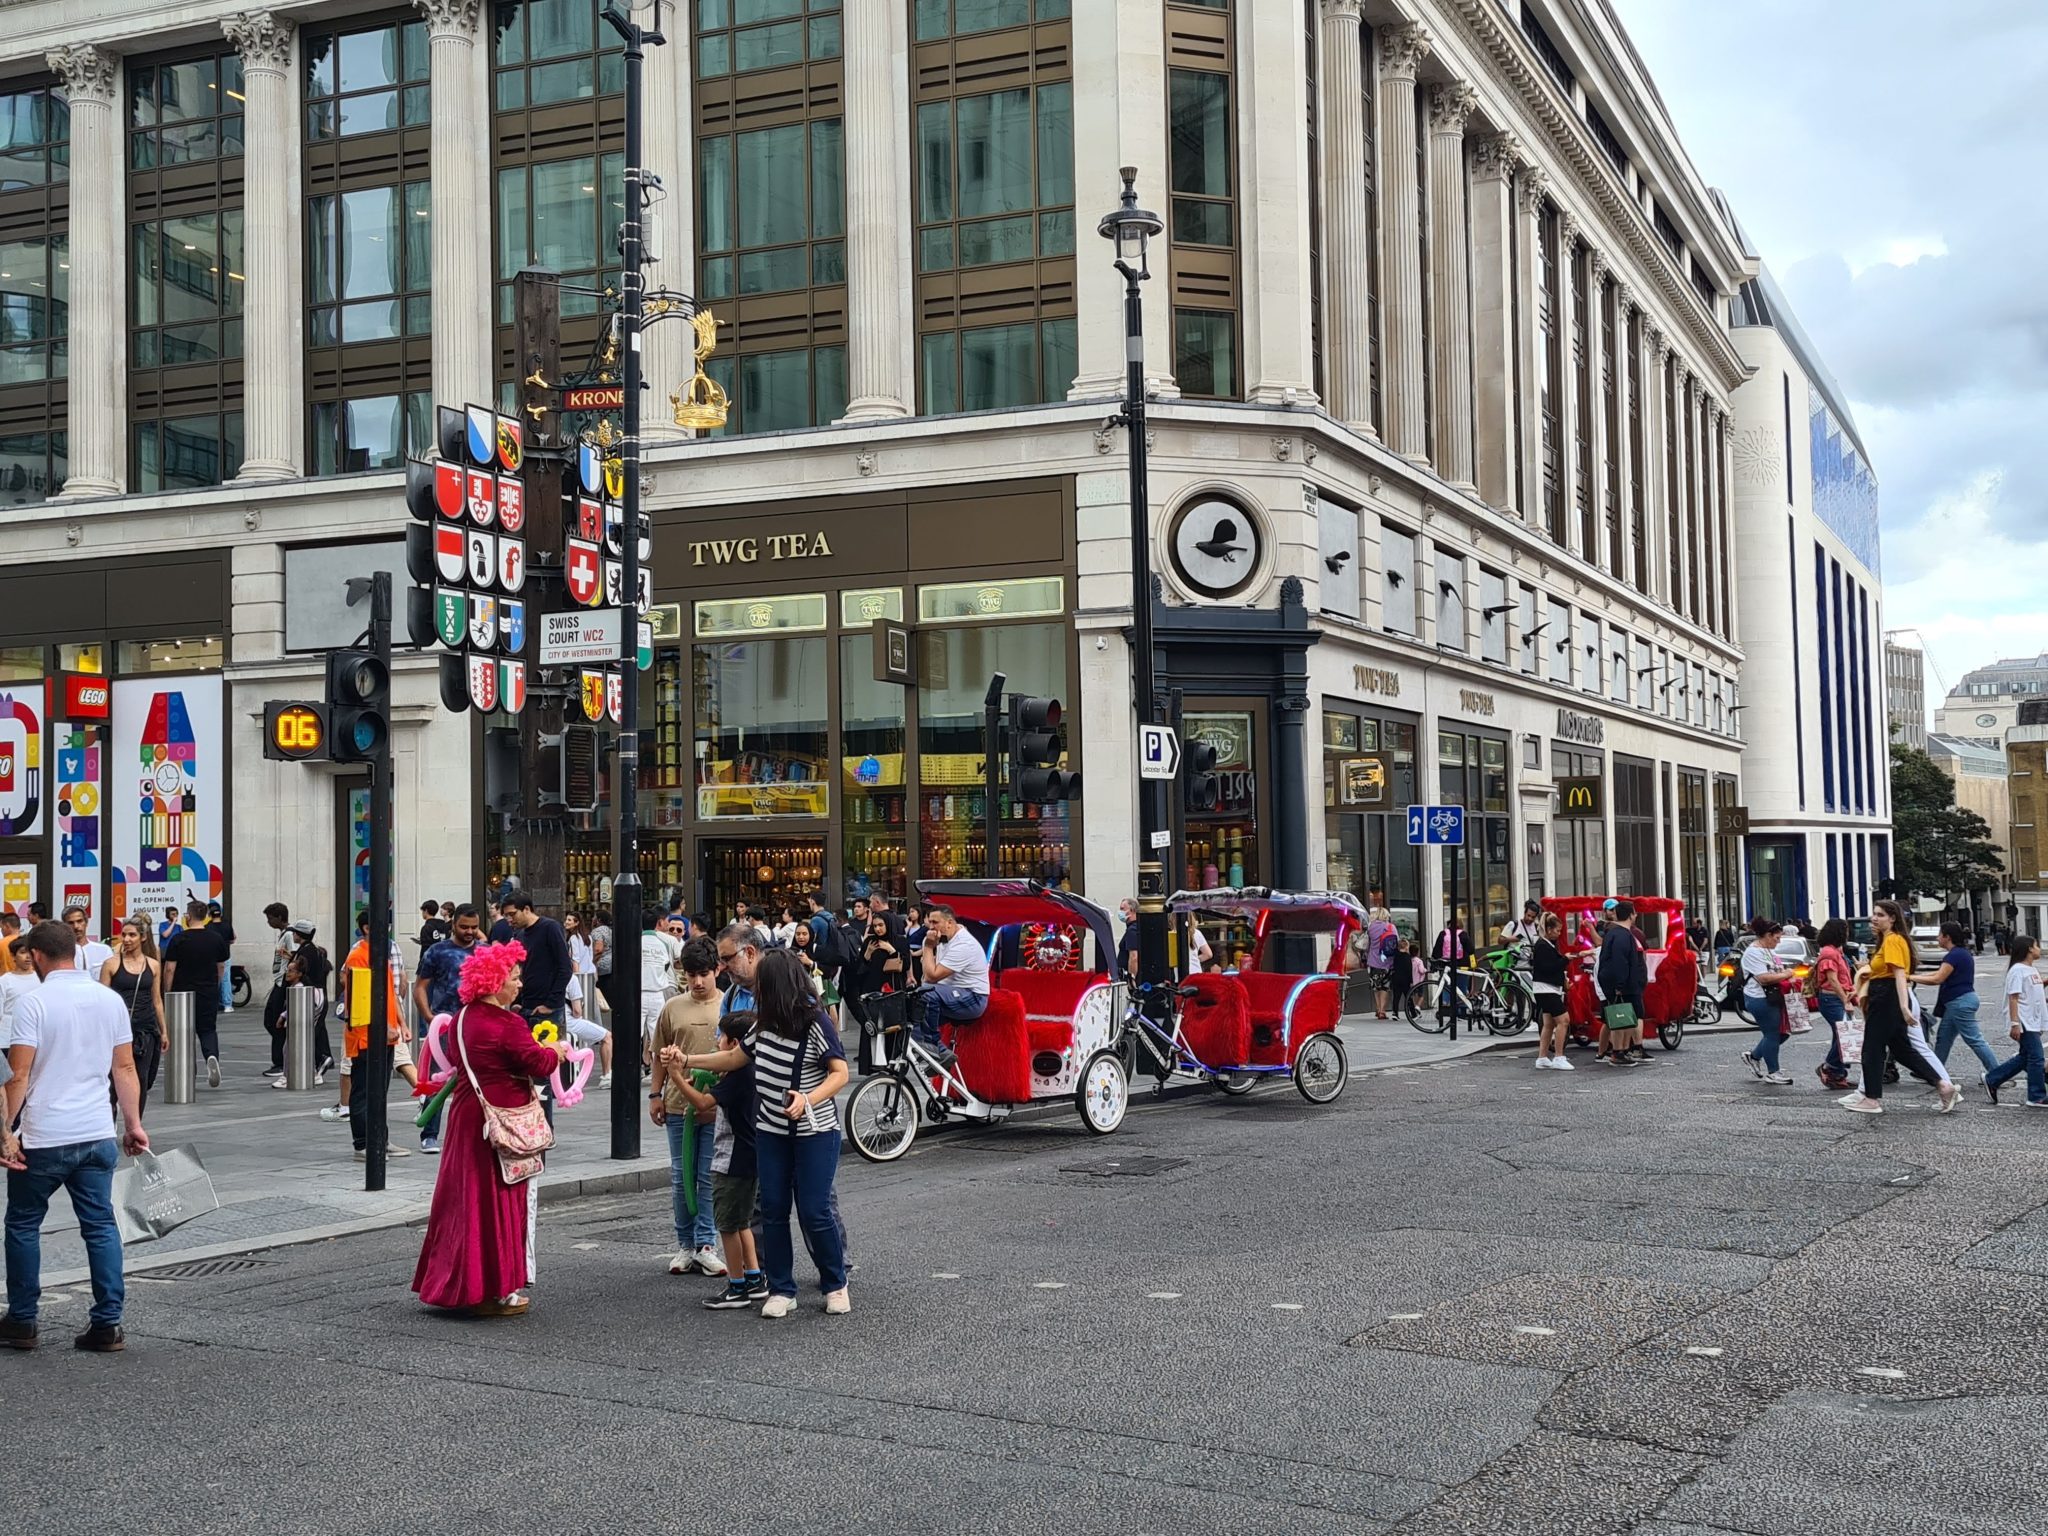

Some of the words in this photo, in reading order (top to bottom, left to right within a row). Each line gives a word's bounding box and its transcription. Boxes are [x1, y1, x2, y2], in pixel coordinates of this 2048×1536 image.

[688, 538, 759, 566] TWG
[767, 531, 833, 560] TEA
[549, 616, 580, 630] SWISS
[548, 631, 580, 645] COURT
[583, 629, 604, 642] WC2
[548, 651, 560, 659] CITY
[562, 650, 569, 658] OF
[571, 648, 613, 657] WESTMINSTER
[79, 687, 107, 706] LEGO
[278, 714, 318, 746] 06
[1148, 733, 1159, 759] P
[1724, 814, 1742, 828] 30
[66, 894, 89, 907] LEGO
[133, 896, 175, 904] RE-OPENING
